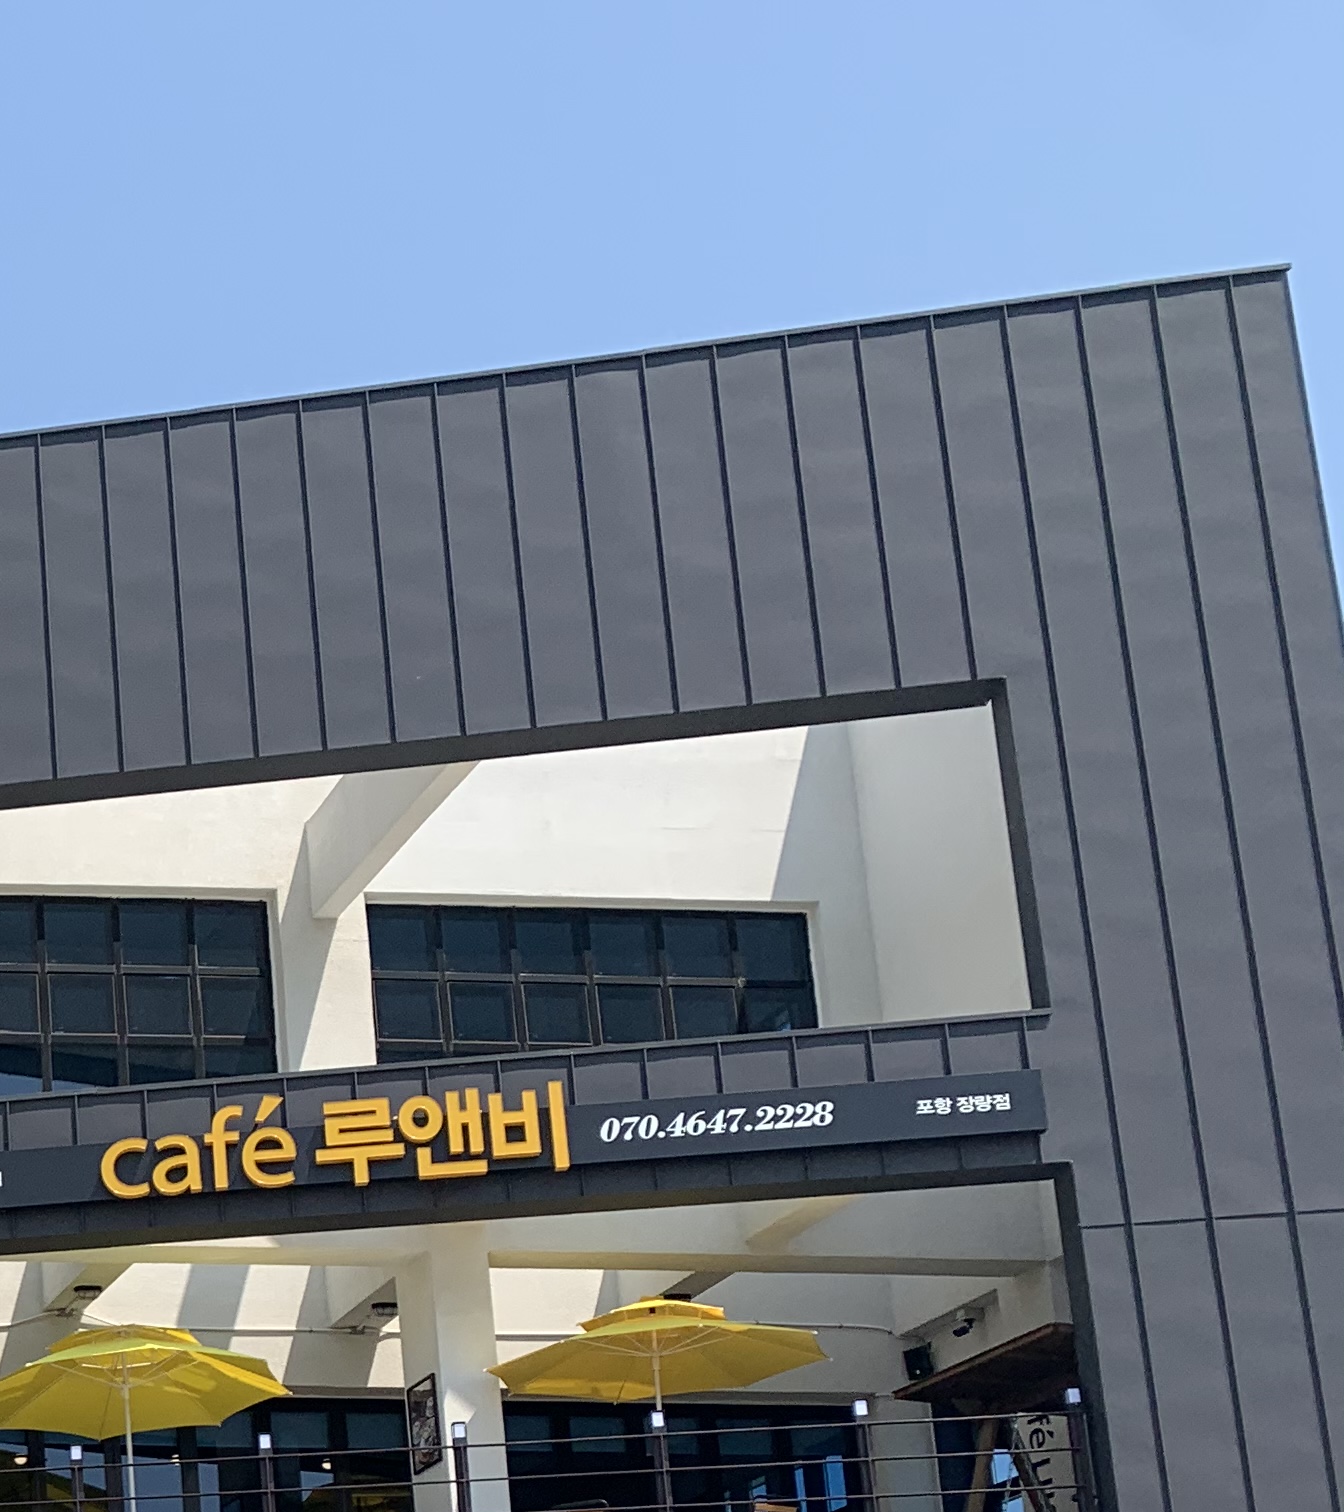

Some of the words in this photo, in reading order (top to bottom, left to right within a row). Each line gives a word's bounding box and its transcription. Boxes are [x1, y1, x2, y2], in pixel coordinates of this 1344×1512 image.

[599, 1101, 835, 1143] 070.4647.2228
[915, 1097, 953, 1116] 포항
[955, 1093, 1012, 1114] 장량점
[100, 1095, 296, 1199] café
[315, 1080, 570, 1187] 루앤비
